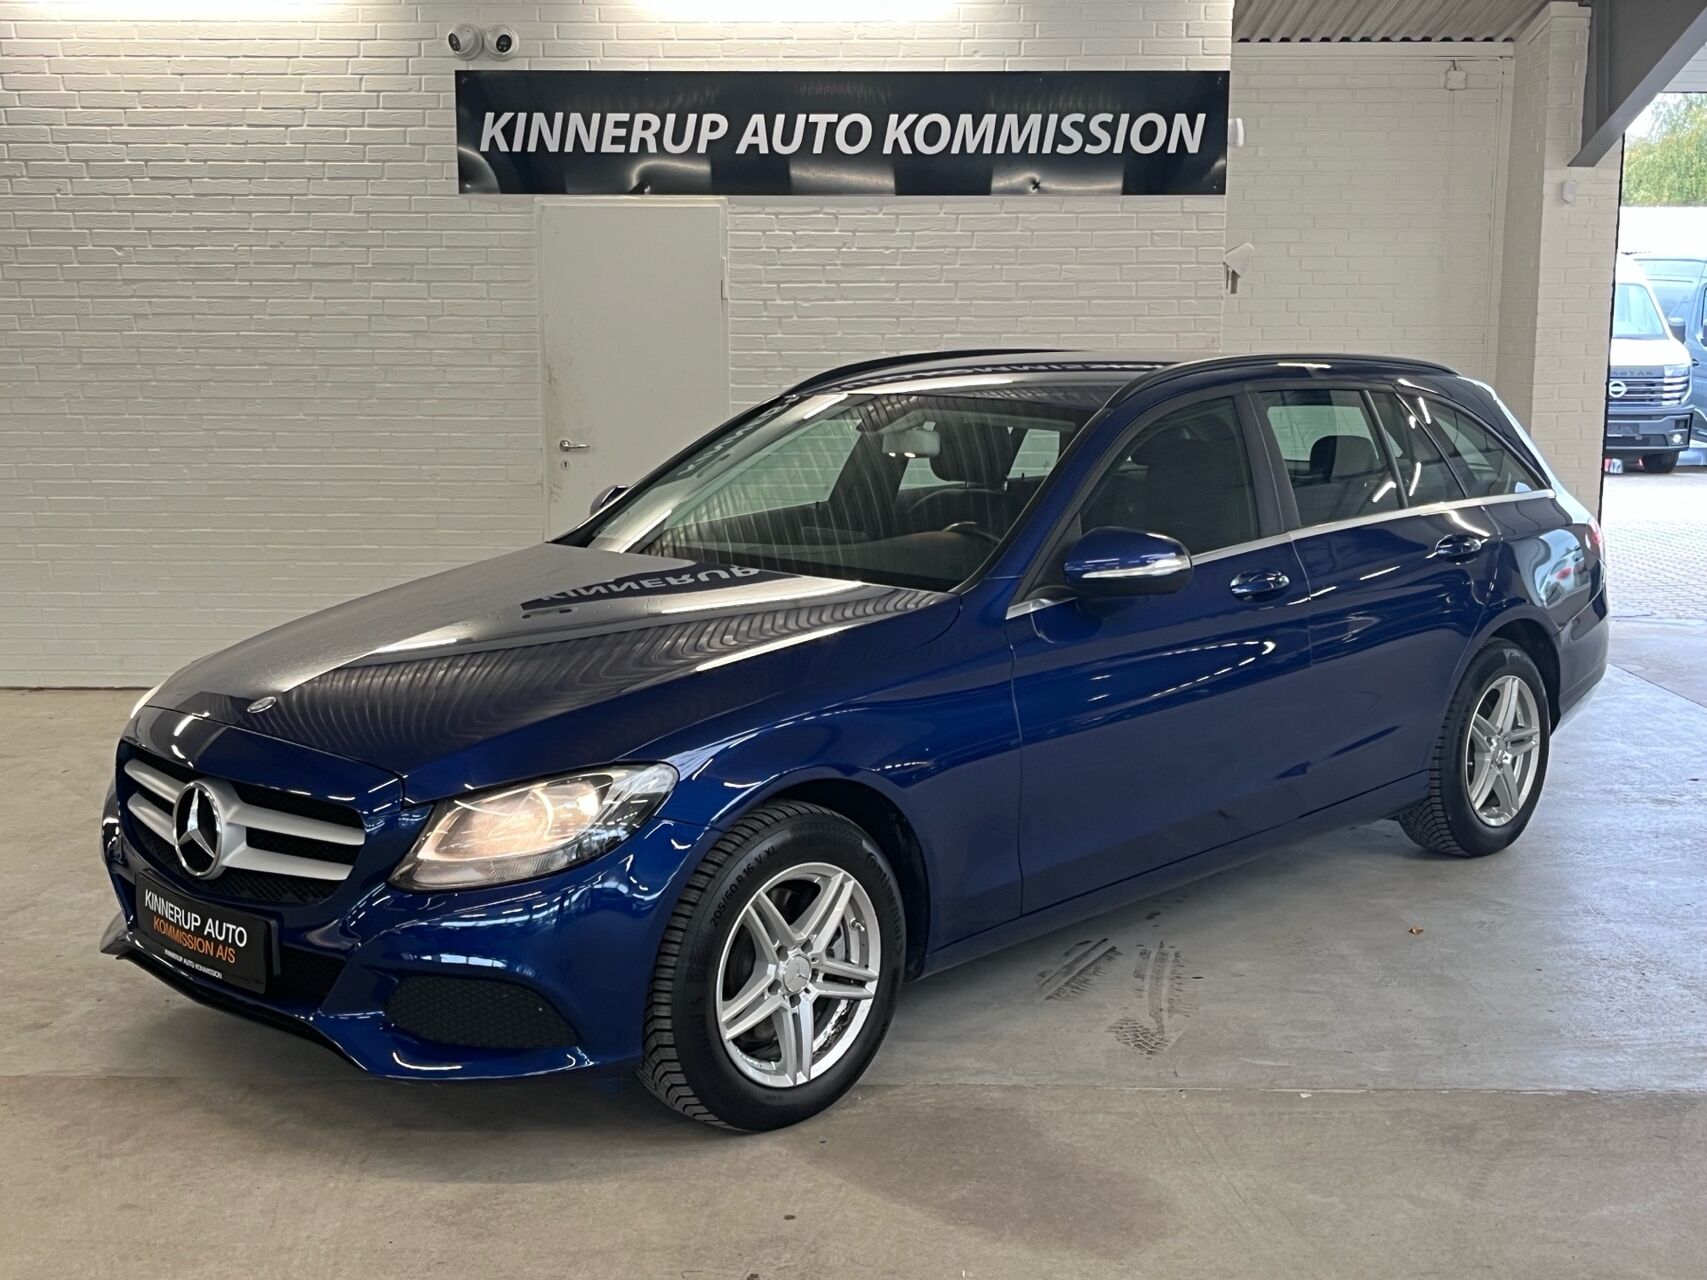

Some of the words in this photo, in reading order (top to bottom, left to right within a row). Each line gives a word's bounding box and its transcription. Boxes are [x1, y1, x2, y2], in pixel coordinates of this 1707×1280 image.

[480, 112, 728, 154] KINNERUP
[735, 113, 872, 155] AUTO
[882, 112, 1206, 155] KOMMISSION
[144, 888, 201, 932] KINNERUP
[203, 917, 248, 948] AUTO
[710, 883, 738, 928] 205/60
[743, 863, 754, 877] 16
[153, 915, 214, 957] KOMMISSION
[215, 943, 236, 964] A/S
